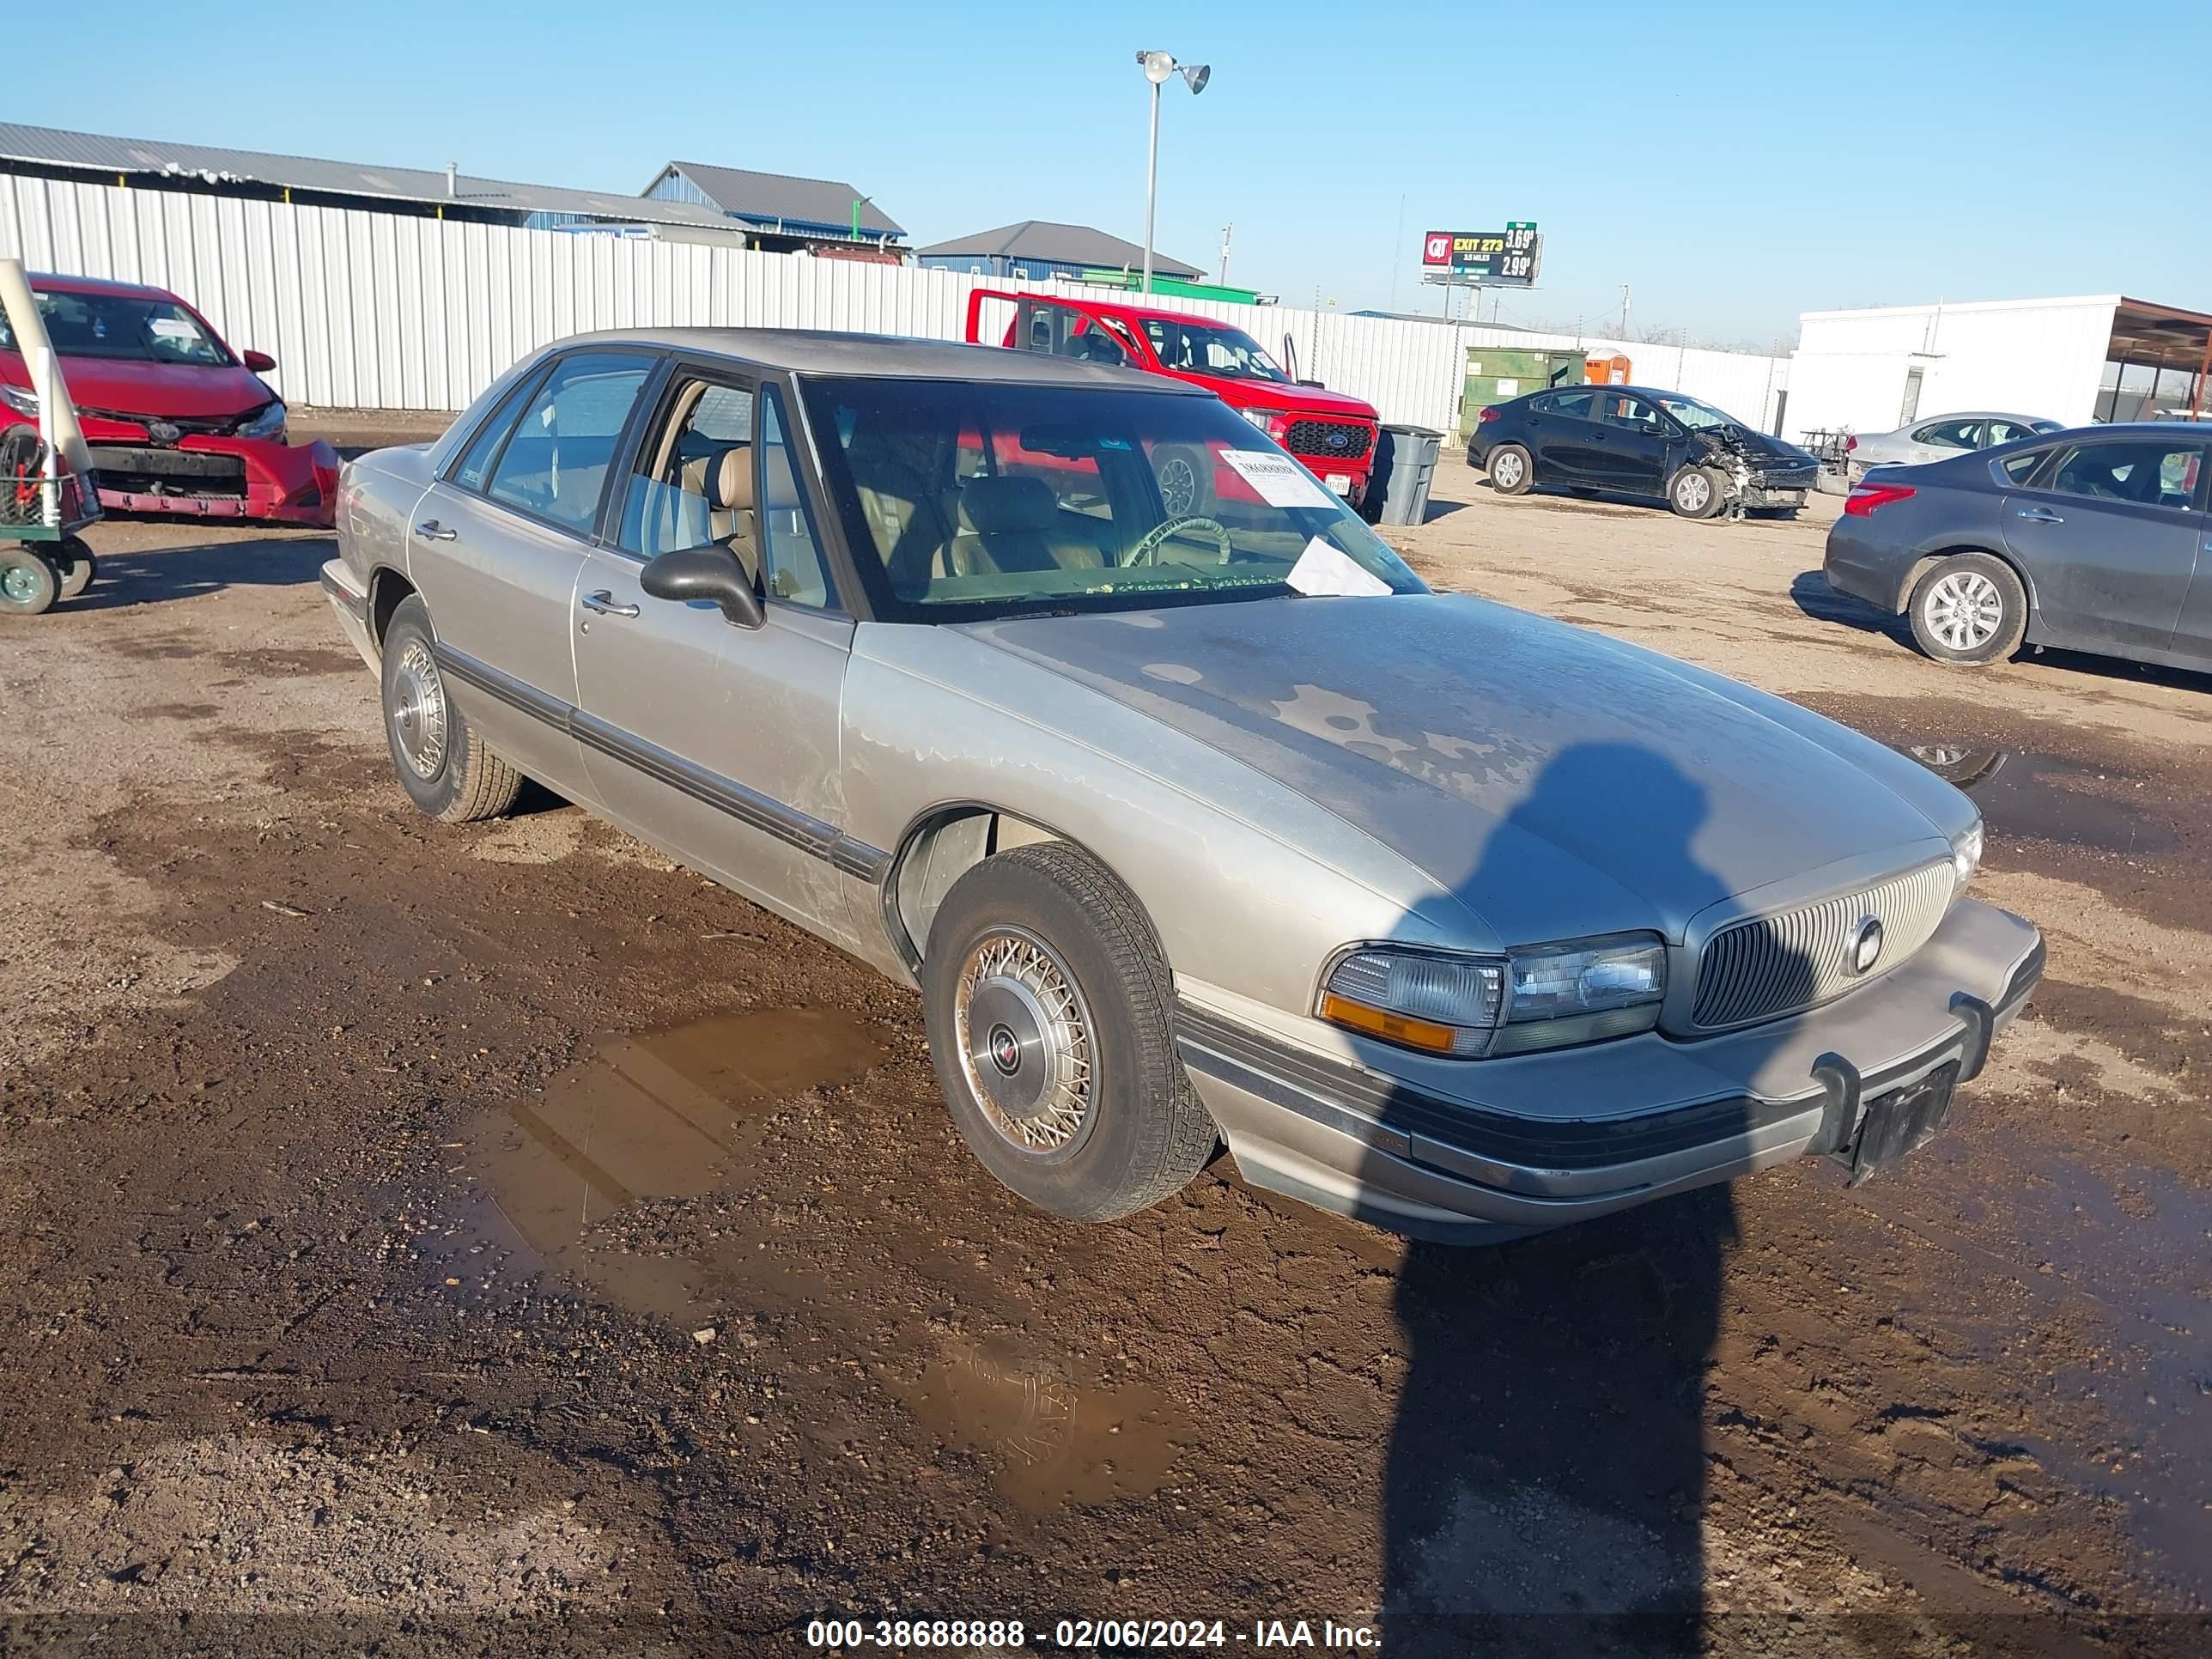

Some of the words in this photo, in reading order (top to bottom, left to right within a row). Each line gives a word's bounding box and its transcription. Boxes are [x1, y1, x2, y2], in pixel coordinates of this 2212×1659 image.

[1427, 238, 1449, 258] QT
[1454, 238, 1480, 251] EXIT
[1481, 239, 1504, 252] 273
